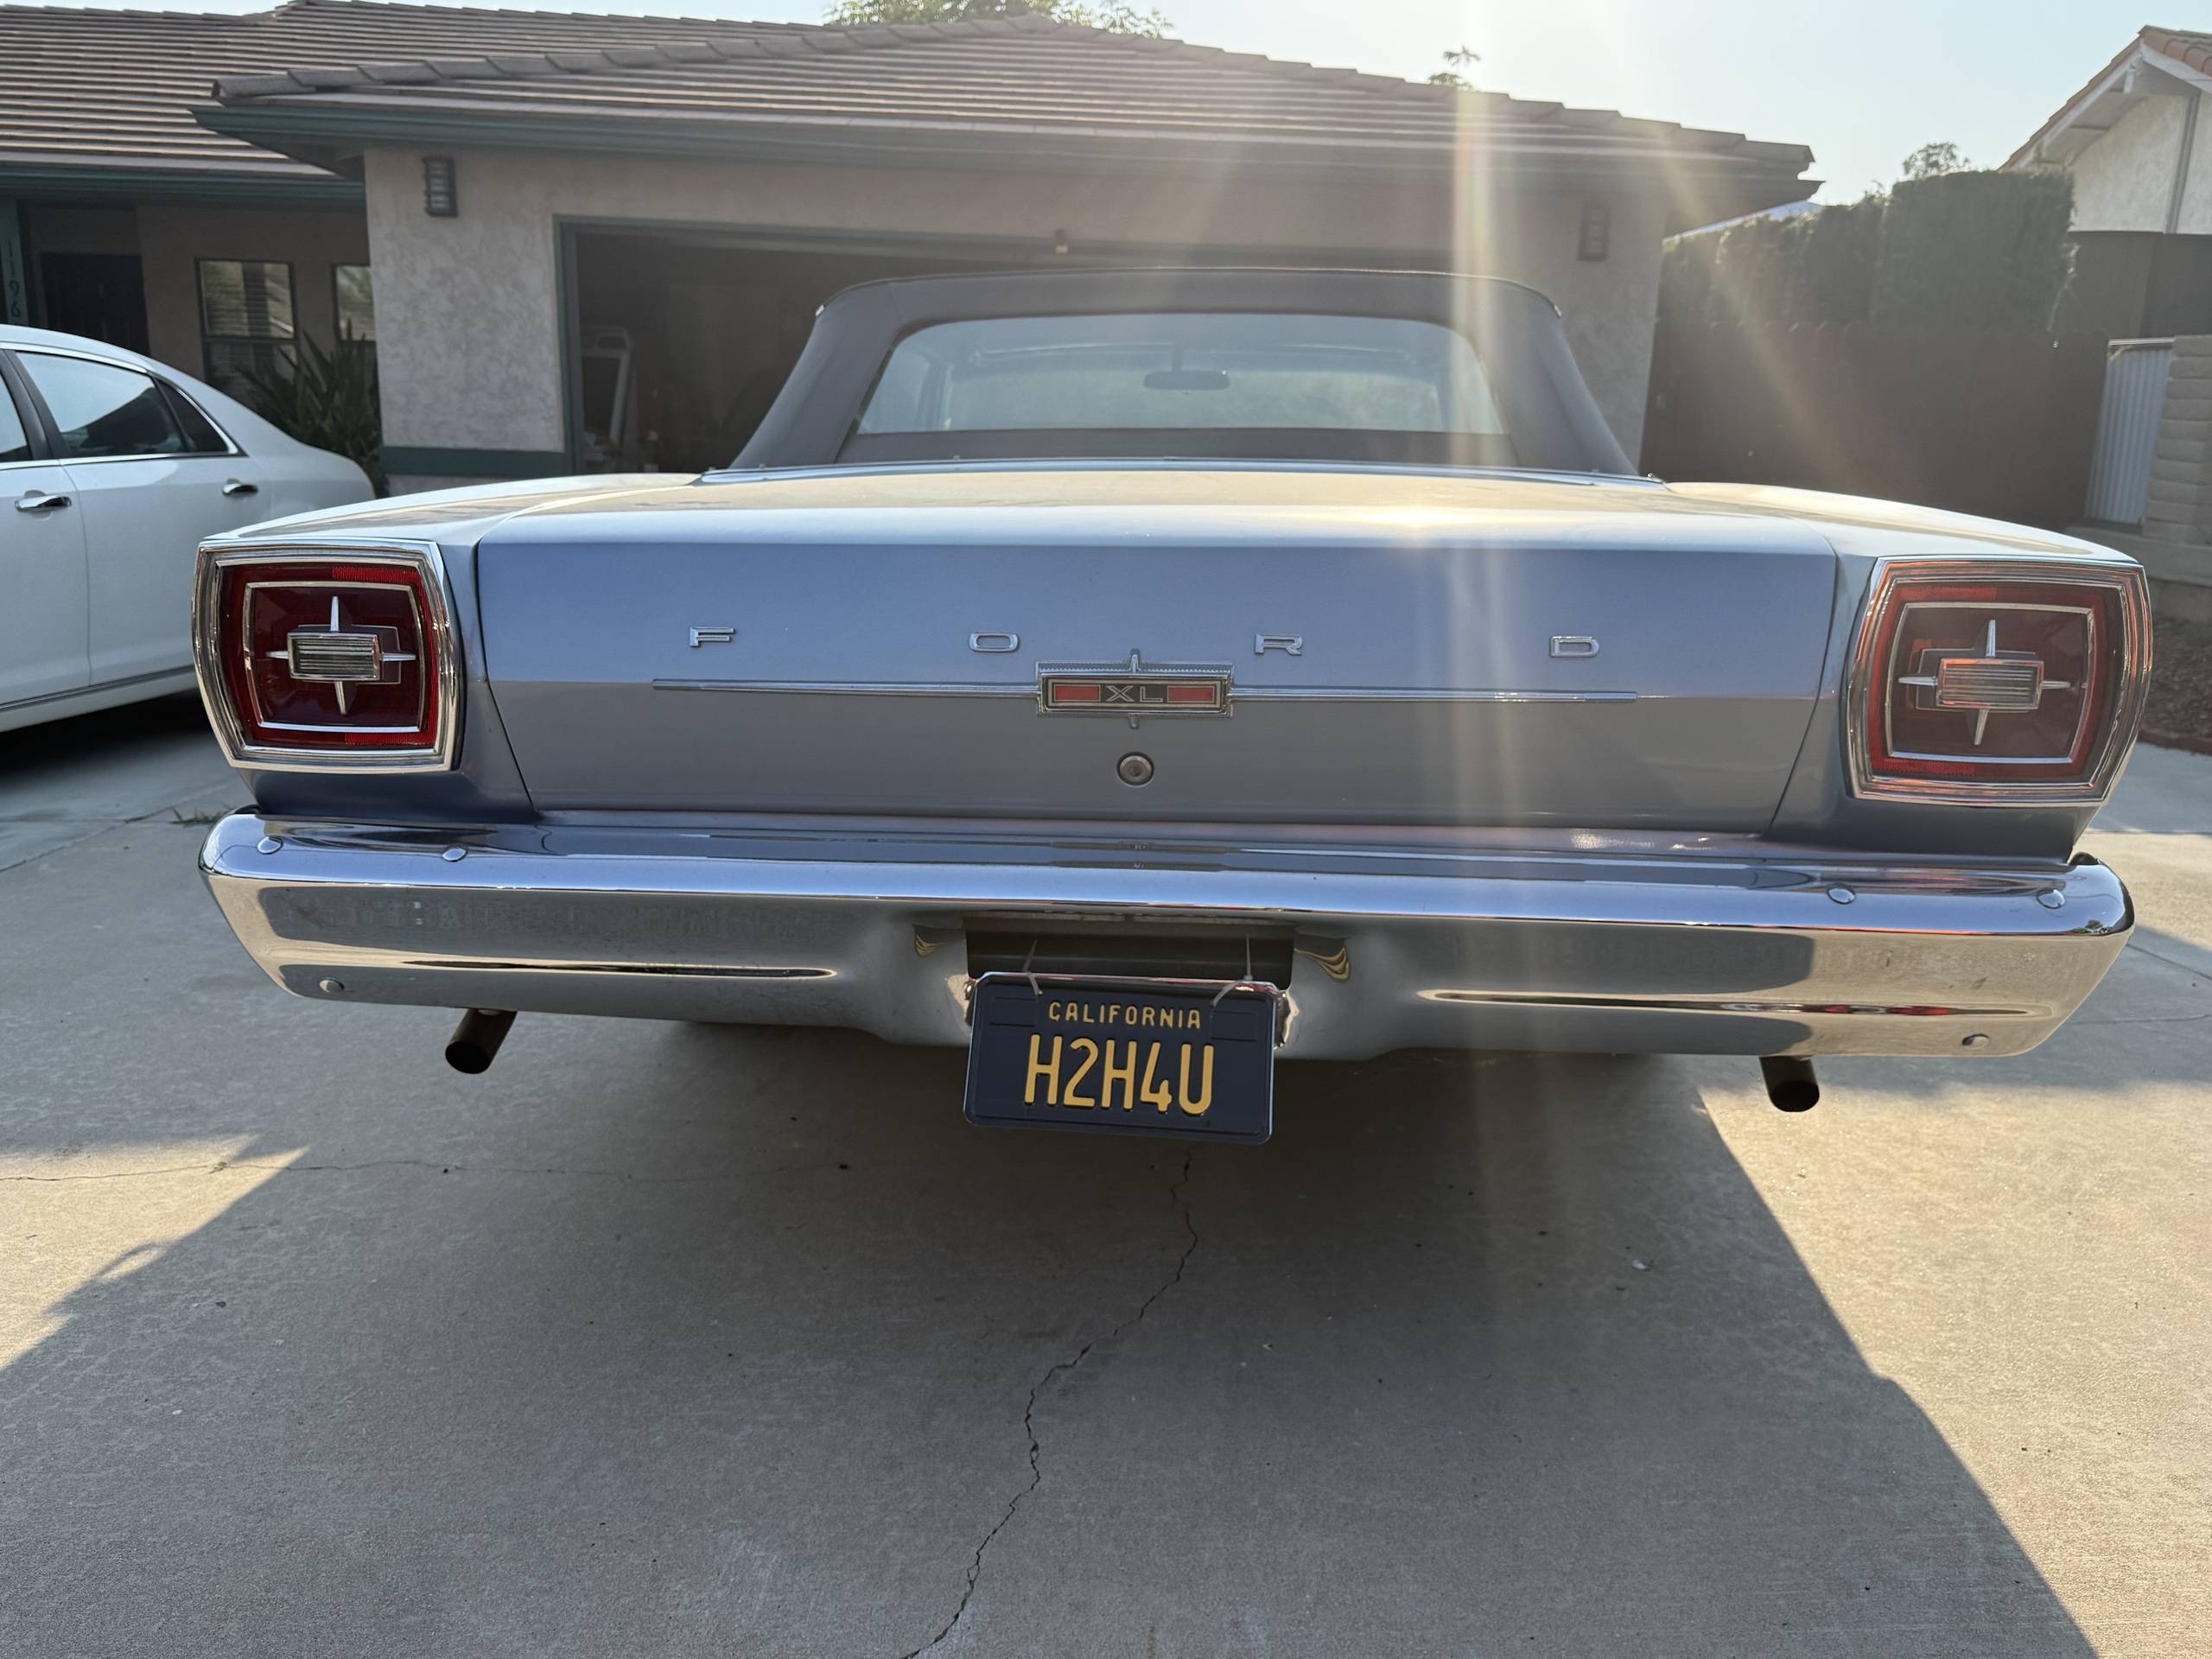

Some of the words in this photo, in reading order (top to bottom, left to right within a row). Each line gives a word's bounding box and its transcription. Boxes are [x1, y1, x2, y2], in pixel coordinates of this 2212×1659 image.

[8, 239, 22, 318] 1196
[690, 626, 1600, 658] FORD
[1105, 684, 1163, 702] XL
[1049, 1001, 1201, 1029] CALIFORNIA
[1024, 1034, 1215, 1116] H2H4U
